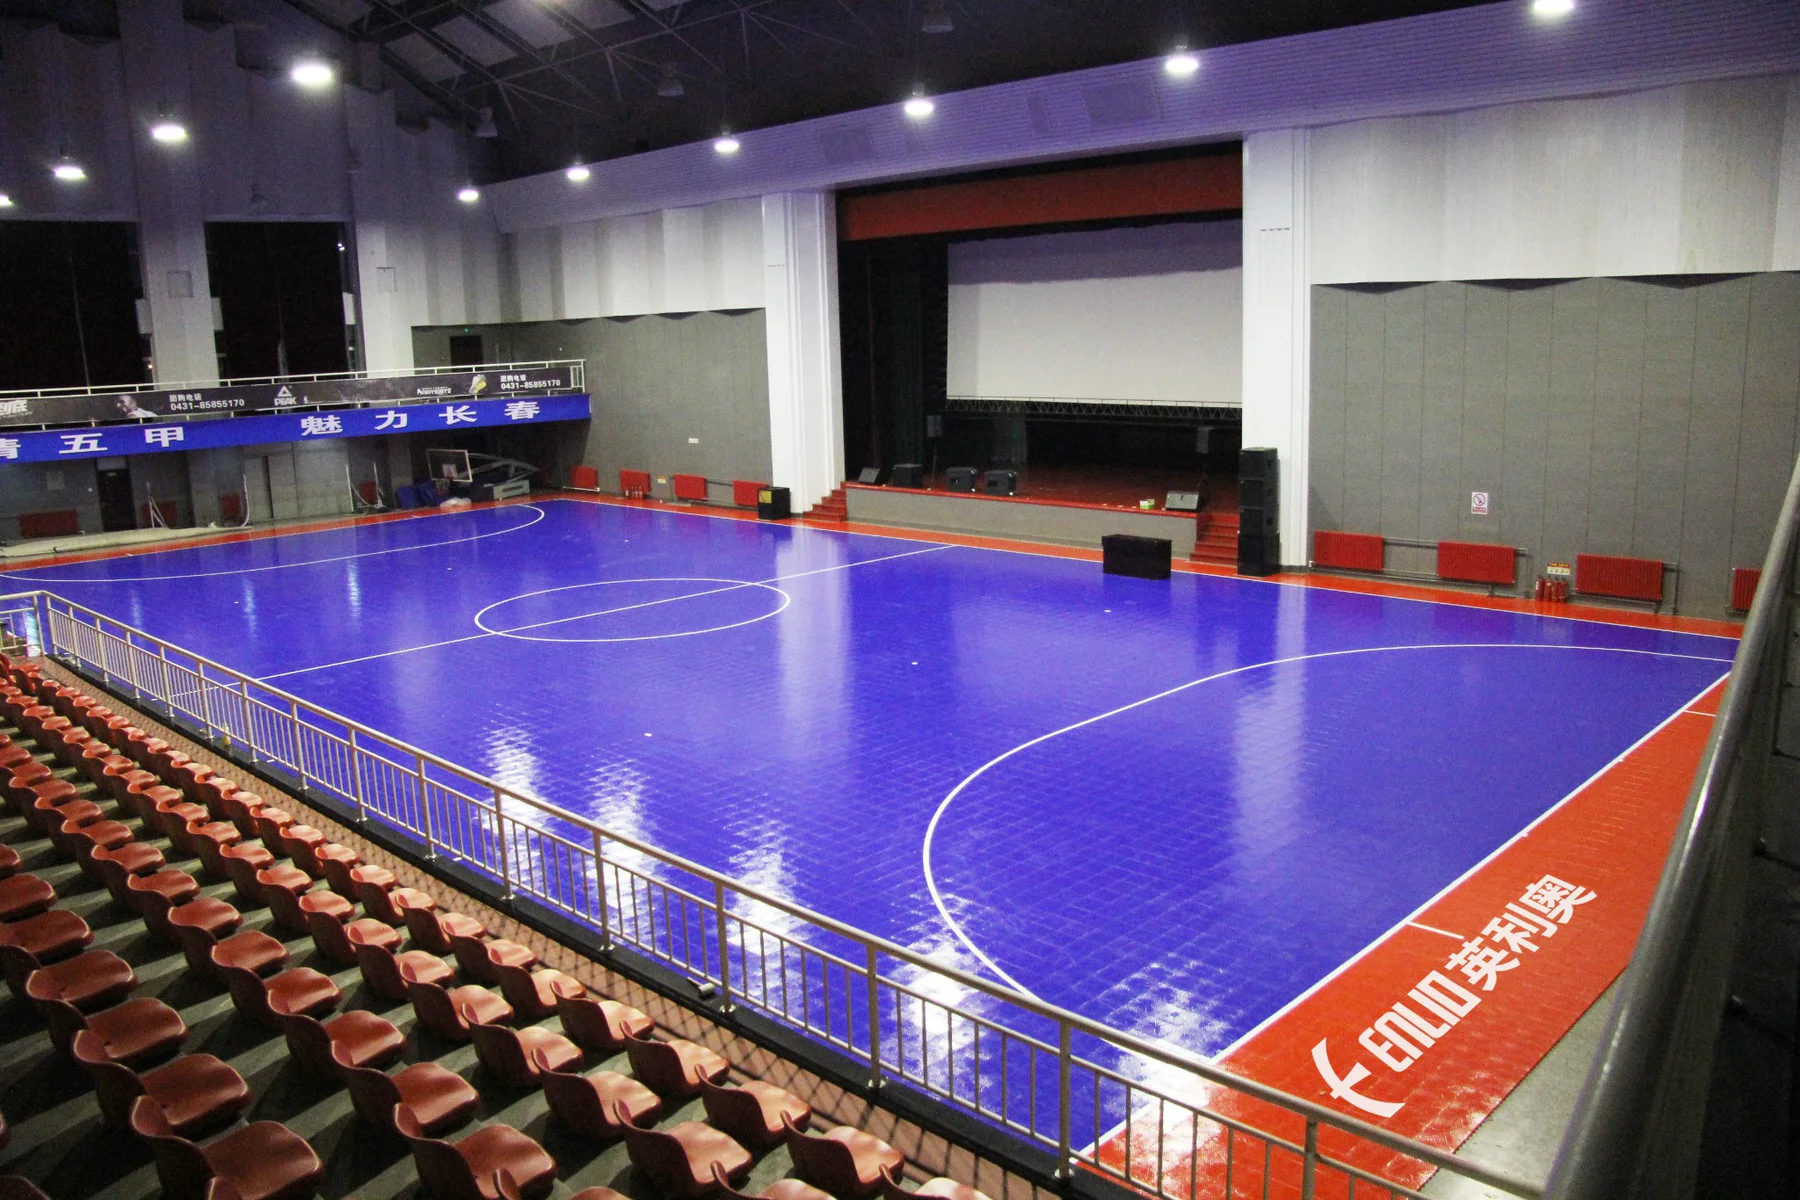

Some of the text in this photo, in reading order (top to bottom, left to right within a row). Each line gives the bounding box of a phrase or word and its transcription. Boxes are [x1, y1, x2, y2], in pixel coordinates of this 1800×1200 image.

[501, 379, 561, 390] 0431-85855170
[170, 398, 245, 411] 0431-85855170
[274, 396, 297, 406] PEAK
[300, 400, 541, 437] 魅力长春
[1358, 873, 1597, 1072] ENLIO 英利奥
